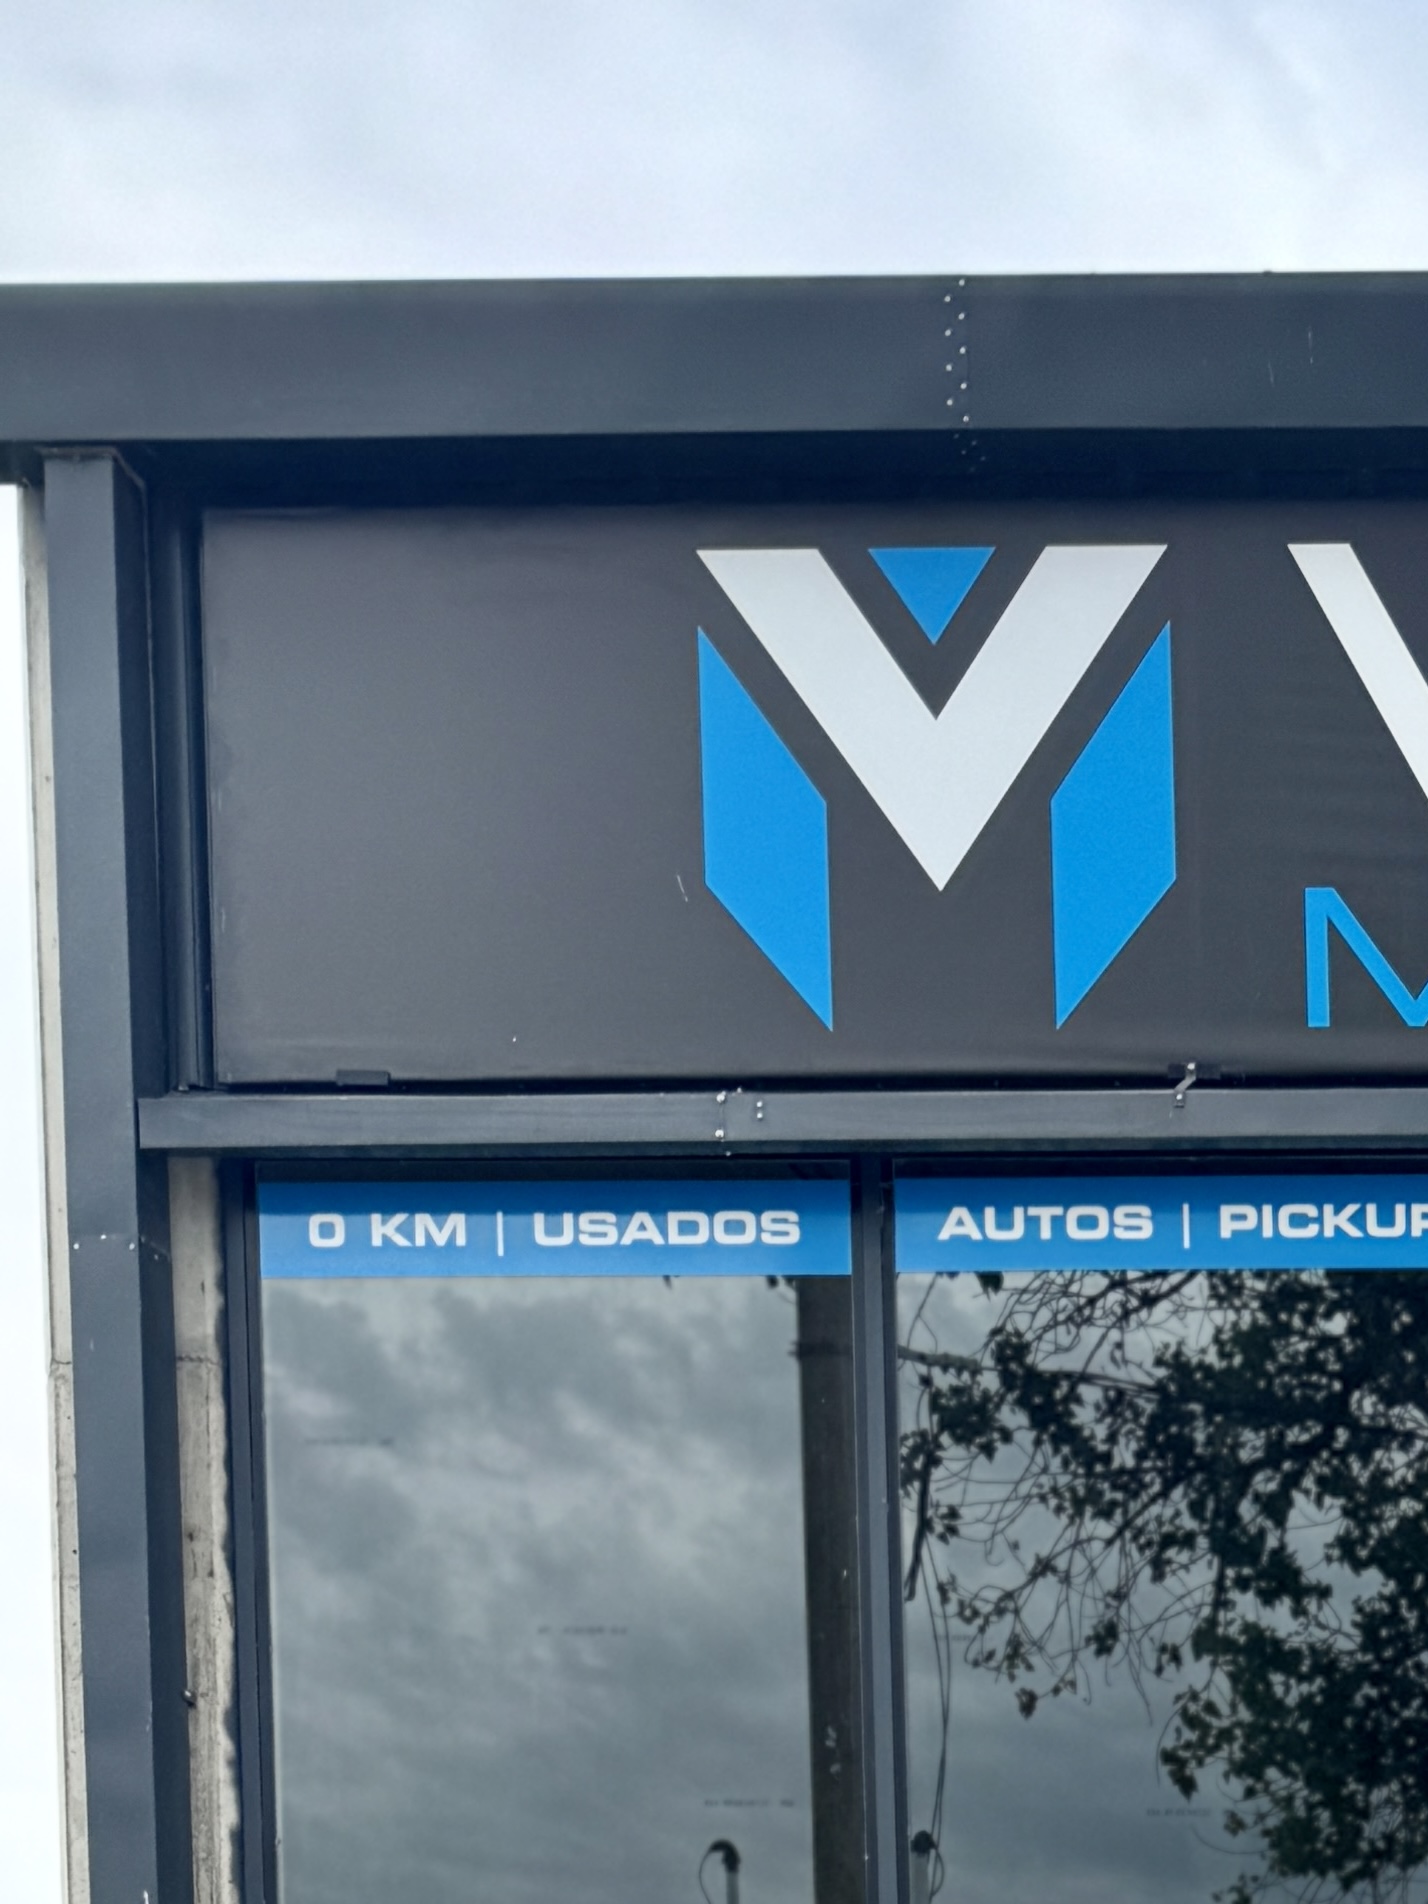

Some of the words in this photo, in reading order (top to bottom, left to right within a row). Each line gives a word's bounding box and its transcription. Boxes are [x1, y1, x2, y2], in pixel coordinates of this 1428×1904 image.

[308, 1213, 346, 1248] 0
[370, 1213, 467, 1248] KM
[533, 1211, 801, 1247] USADOS
[937, 1205, 1153, 1241] AUTOS
